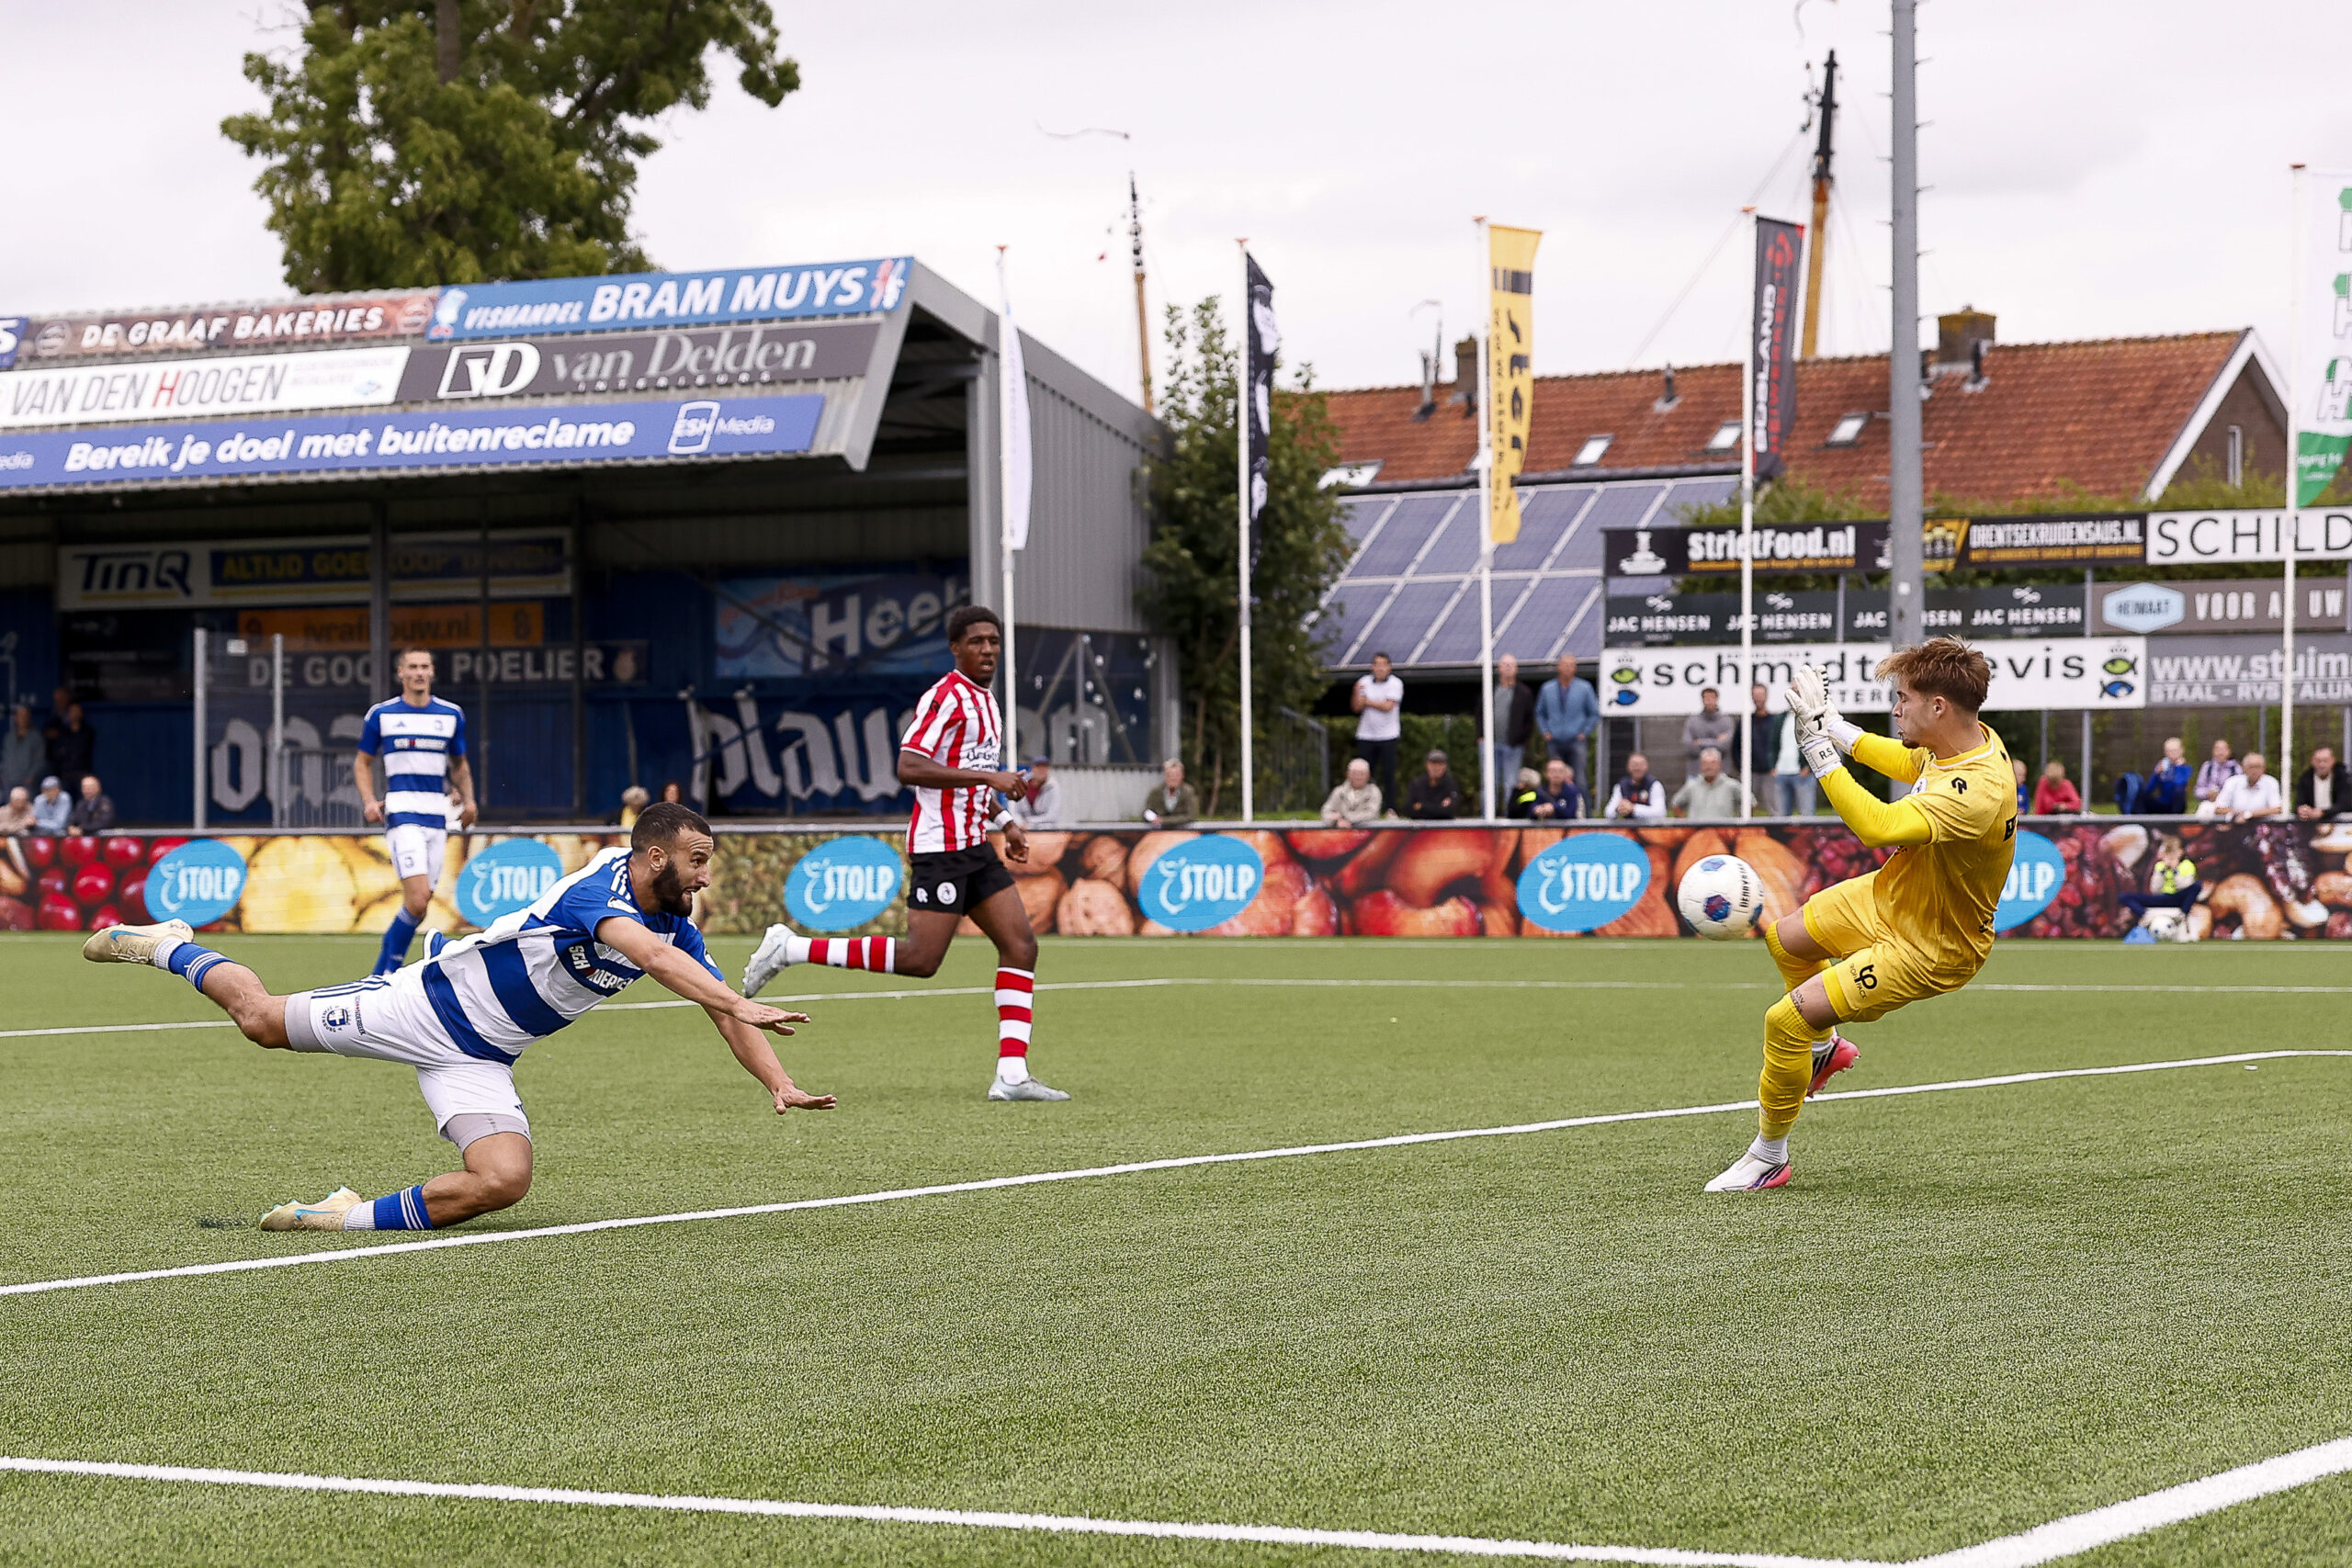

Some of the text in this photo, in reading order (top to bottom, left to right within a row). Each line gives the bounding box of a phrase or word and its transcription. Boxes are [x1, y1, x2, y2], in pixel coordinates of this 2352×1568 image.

[587, 276, 727, 322] BRAM
[729, 266, 868, 313] MUYS
[81, 306, 384, 349] DE GRAAF BAKERIES
[551, 328, 818, 382] van Delden
[12, 378, 78, 414] VAN
[80, 372, 150, 412] DEN
[152, 360, 289, 409] HOOGEN
[714, 415, 776, 435] Media
[0, 451, 35, 472] edia
[63, 416, 637, 473] Bereik je doel met buitenreclame
[222, 552, 305, 580] ALTIJD
[1760, 613, 1833, 630] HENSEN
[1853, 611, 1888, 628] JAC
[1971, 607, 2082, 626] JAC HENSEN
[2195, 591, 2256, 621] VOOR
[2308, 589, 2345, 618] UW
[1607, 615, 1711, 632] JAC HENSEN
[452, 649, 605, 682] POELIER
[2151, 645, 2352, 682] www.stuim
[2151, 682, 2218, 703] STAAL
[177, 867, 241, 902] STOLP
[490, 866, 558, 902] STOLP
[823, 863, 895, 904] STOLP
[1180, 863, 1256, 903] STOLP
[1565, 862, 1642, 902] STOLP
